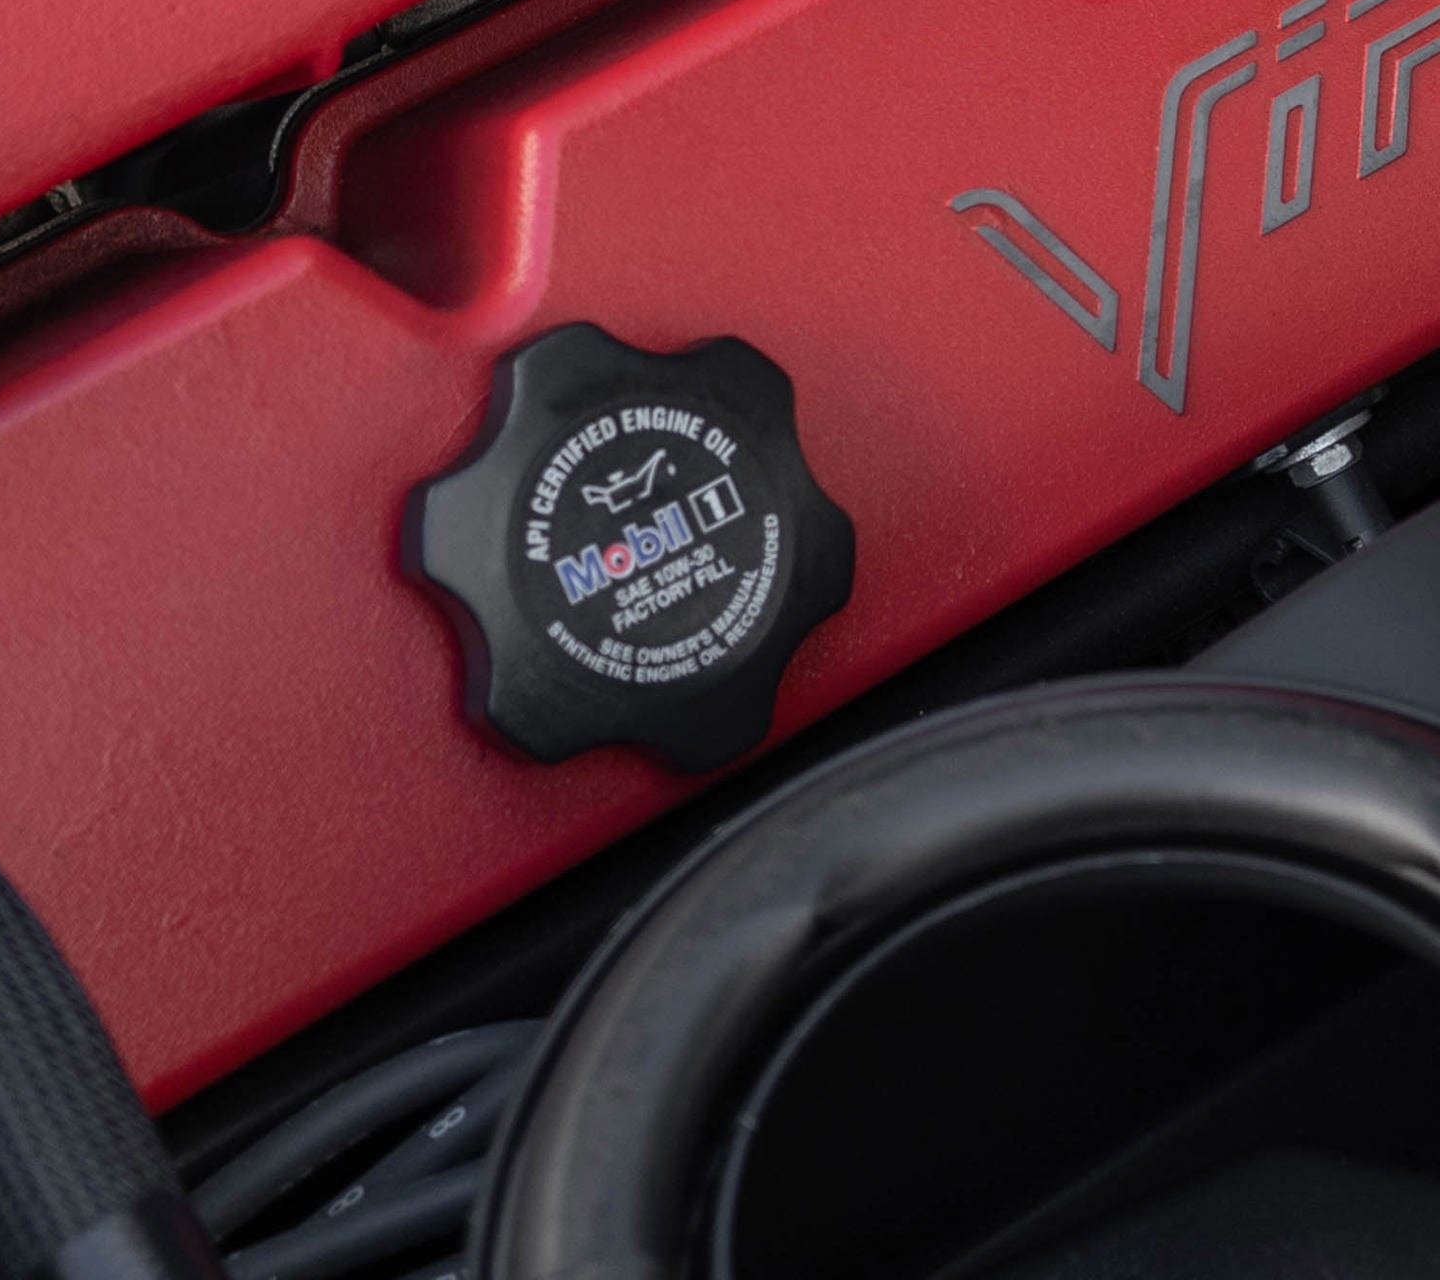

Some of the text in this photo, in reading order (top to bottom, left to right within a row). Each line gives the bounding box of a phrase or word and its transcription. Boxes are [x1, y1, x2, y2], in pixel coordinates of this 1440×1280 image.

[527, 405, 738, 562] API CERTIFIED ENGINE OIL
[553, 500, 696, 606] Mobil
[611, 557, 736, 634] FACTORY FILL
[614, 543, 716, 608] SAE 10W-30
[546, 513, 781, 684] SYNTHETIC ENGINE OIL RECOMMENDED
[599, 568, 760, 665] SEE OWNER'S MANUAL
[429, 1106, 466, 1138] 8
[328, 1185, 365, 1216] 8
